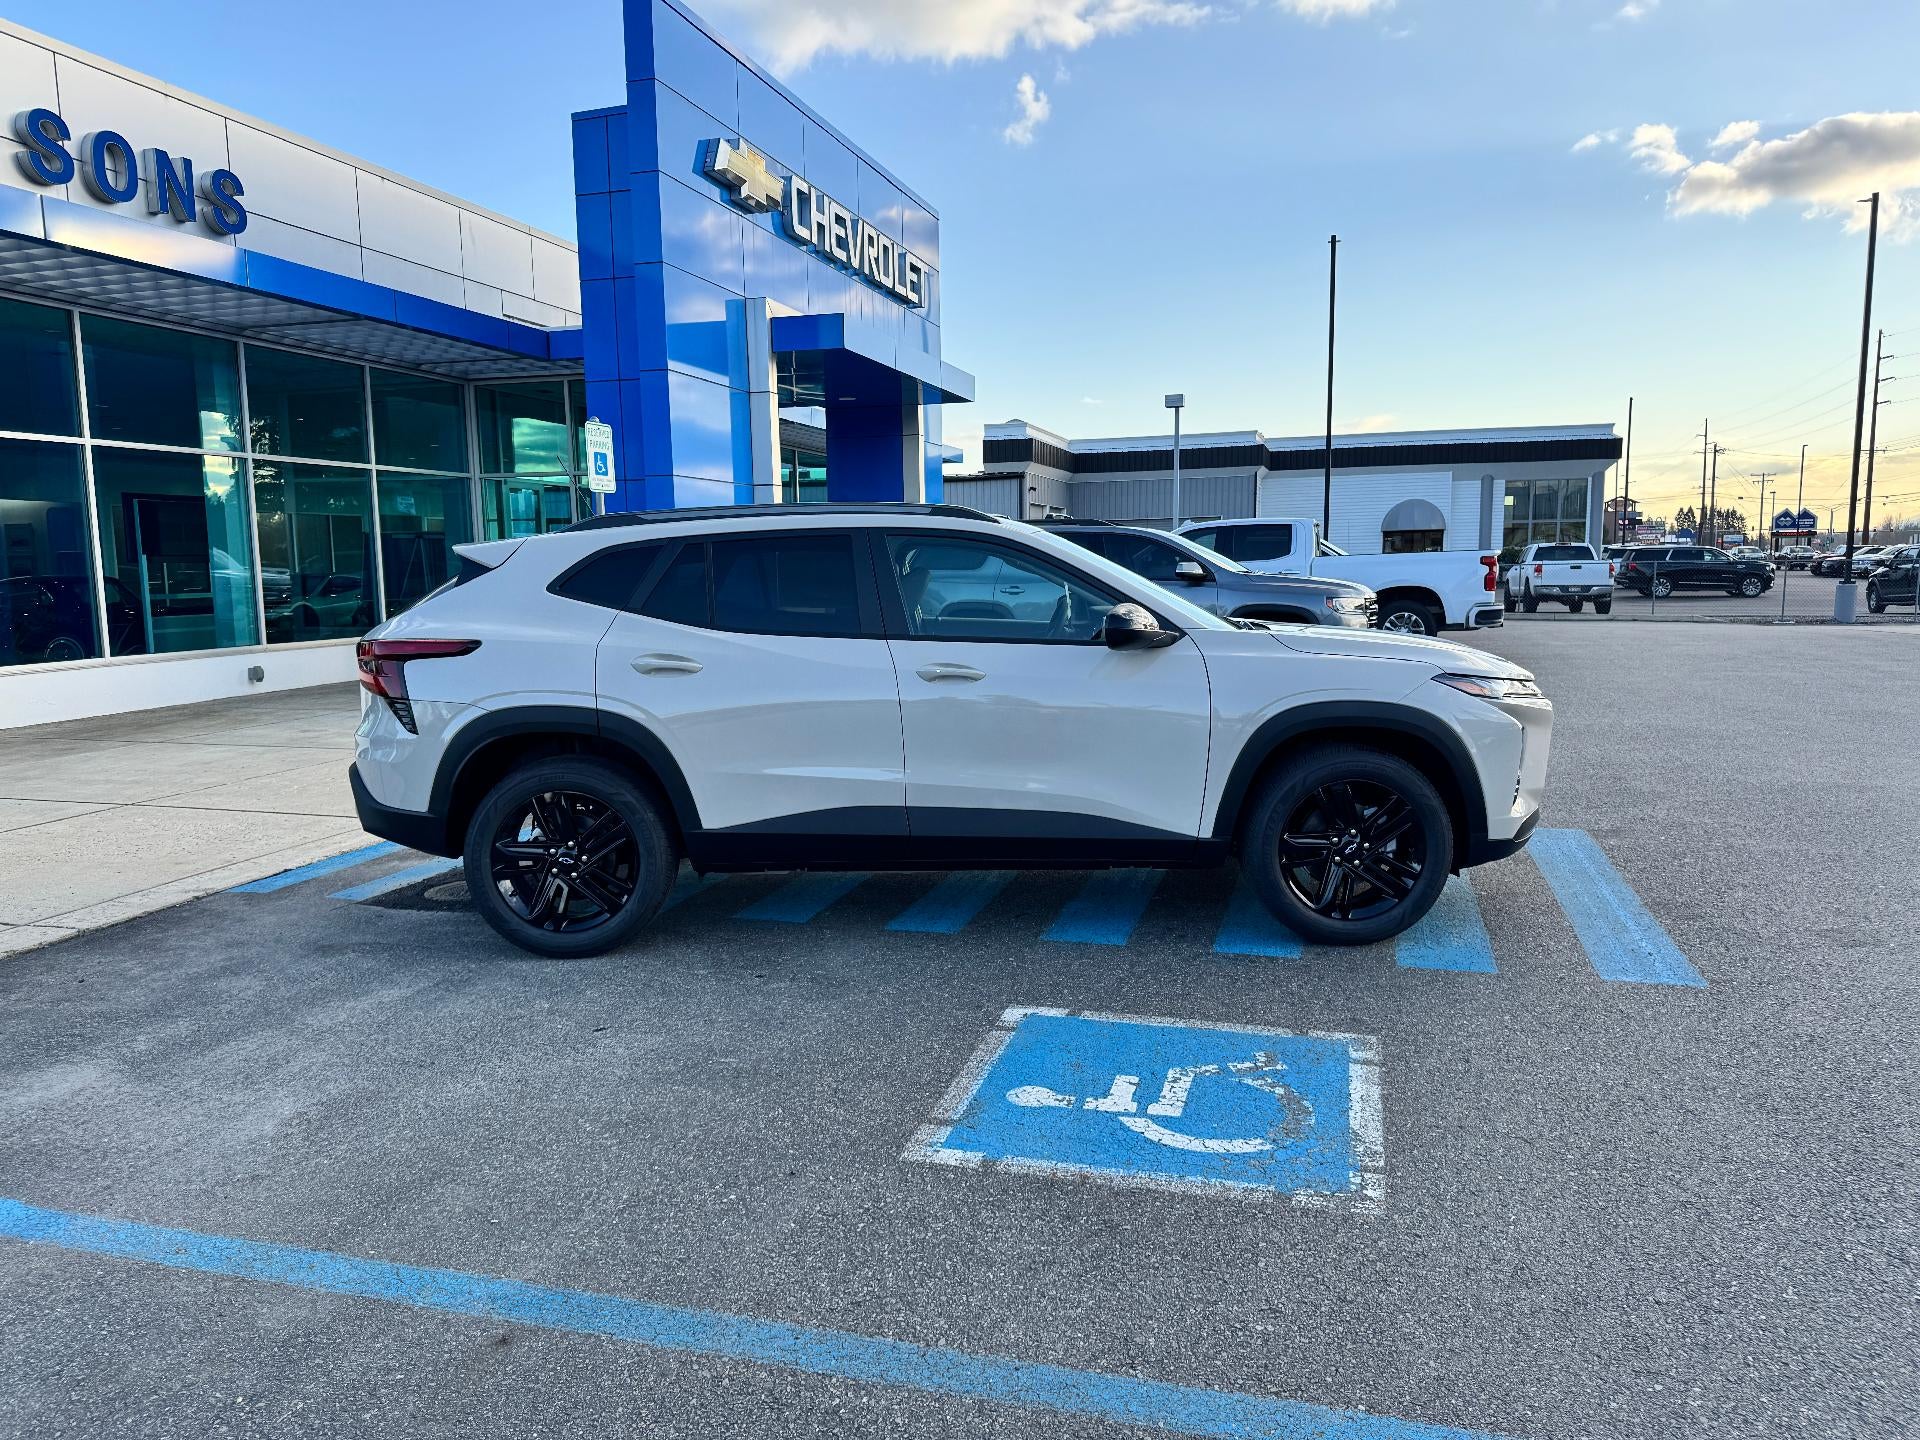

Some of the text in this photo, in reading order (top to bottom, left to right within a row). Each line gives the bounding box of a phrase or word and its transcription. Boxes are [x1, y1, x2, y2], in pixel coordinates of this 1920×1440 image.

[17, 108, 248, 235] SONS
[789, 174, 928, 308] CHEVROLET
[587, 427, 609, 439] RESERVED
[589, 439, 610, 450] PARKING
